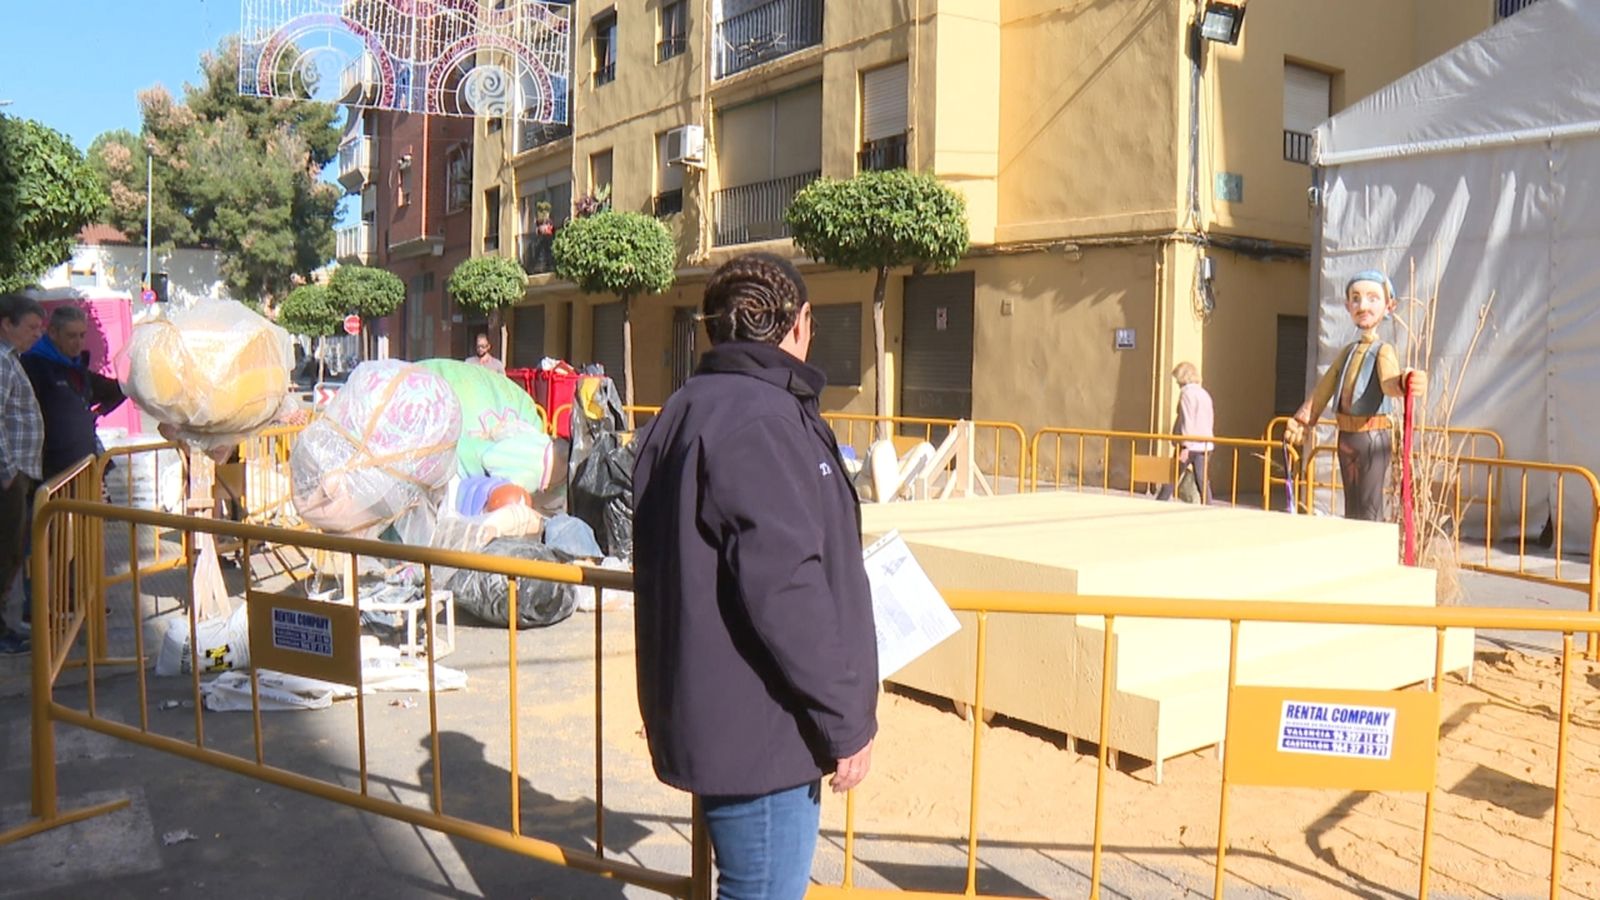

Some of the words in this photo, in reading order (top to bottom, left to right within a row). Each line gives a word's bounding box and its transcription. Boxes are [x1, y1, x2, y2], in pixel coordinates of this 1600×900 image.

[1286, 704, 1328, 721] RENTAL
[1331, 708, 1390, 726] COMPANY
[1286, 728, 1331, 738] VALENCIA
